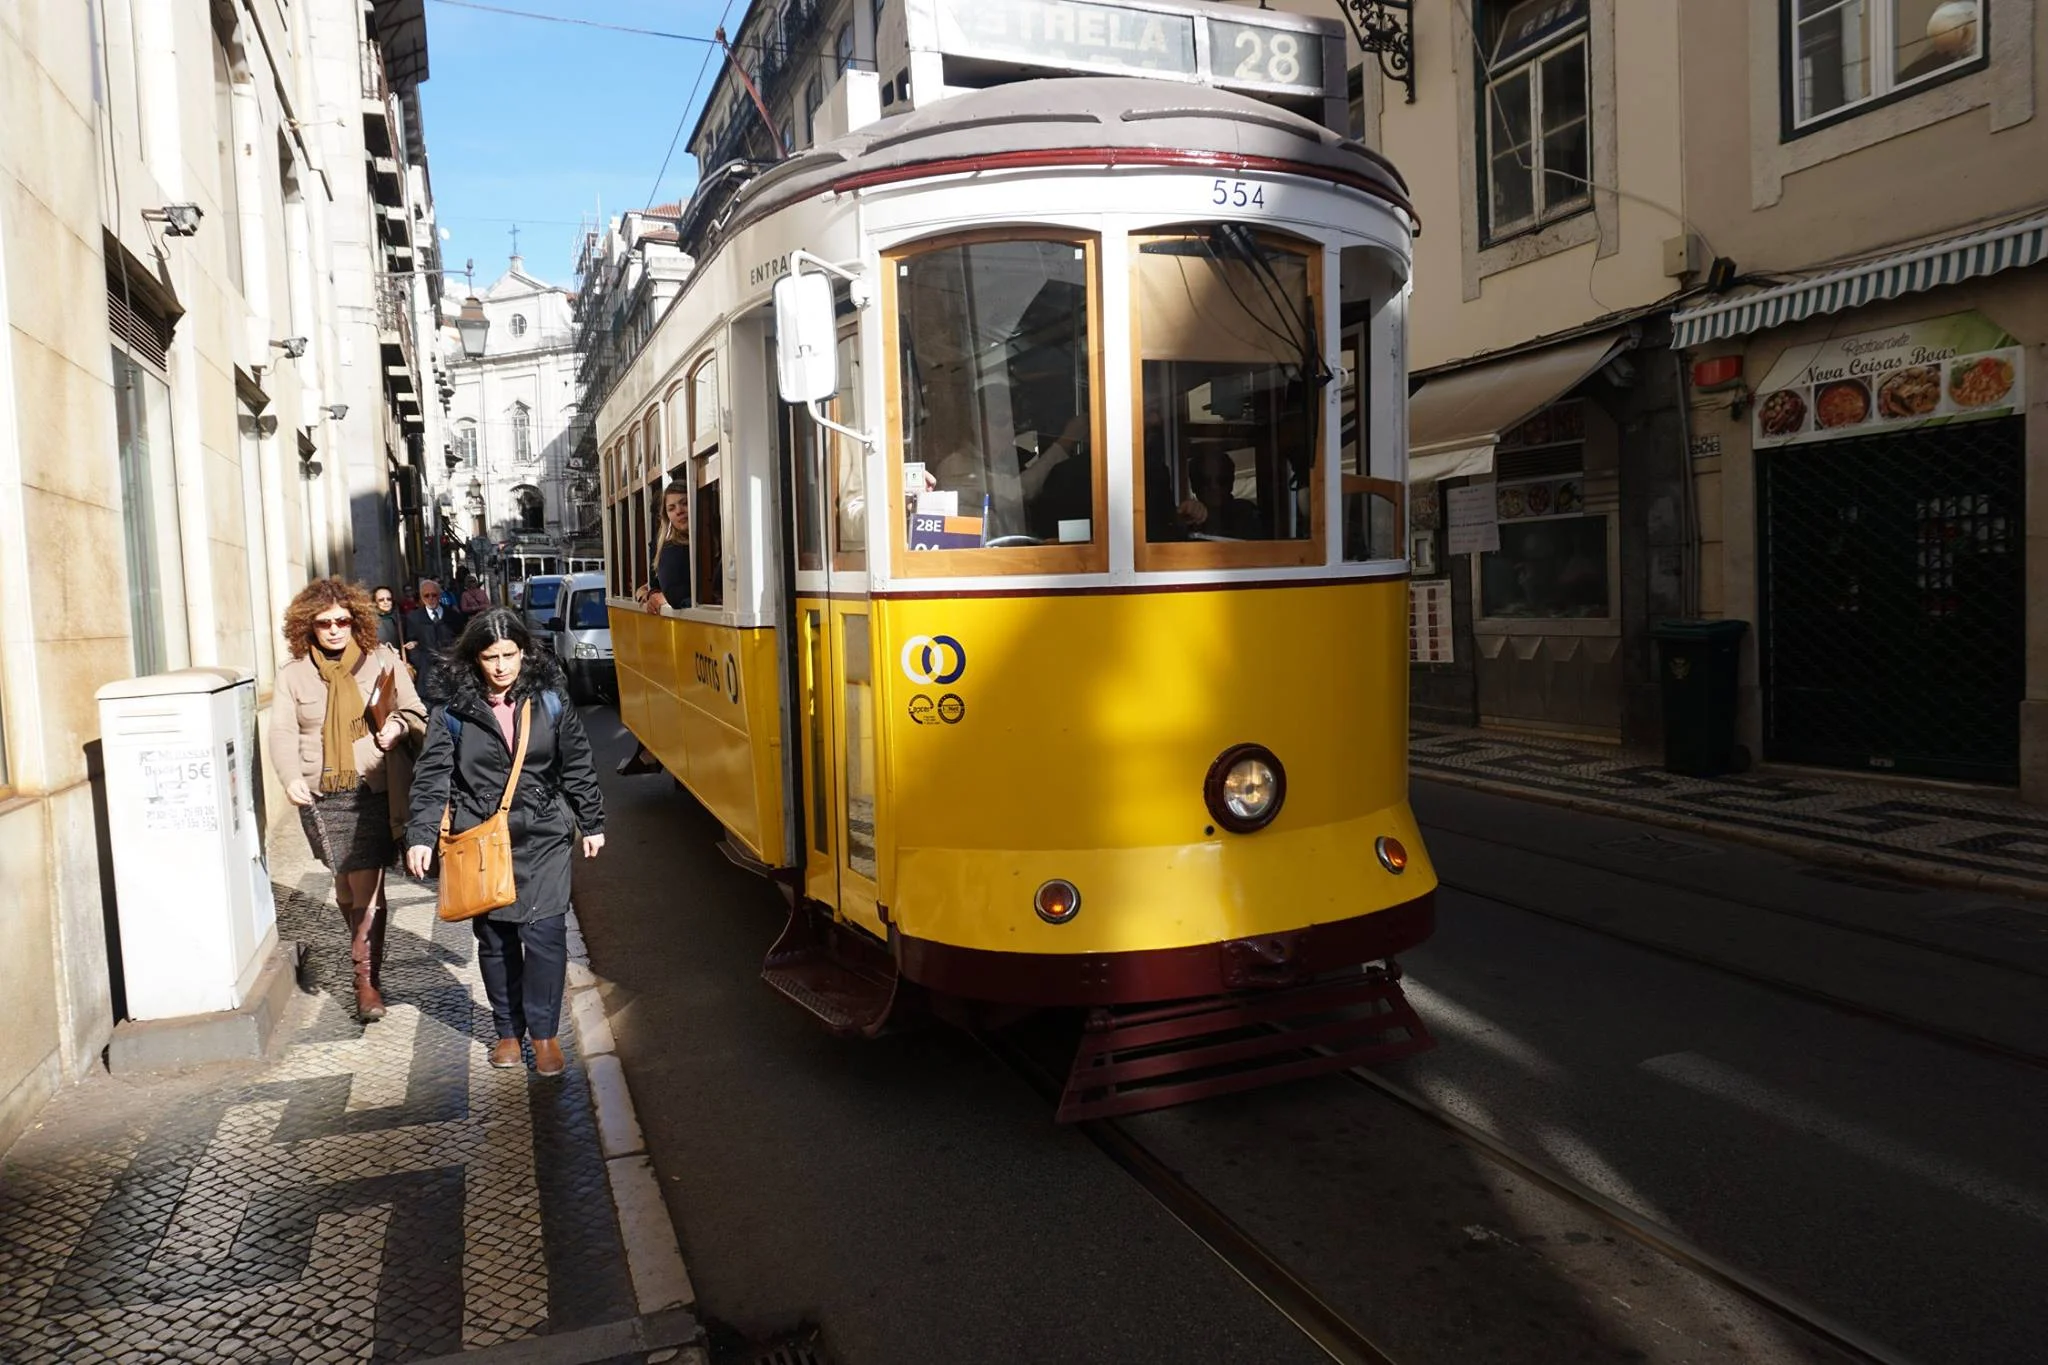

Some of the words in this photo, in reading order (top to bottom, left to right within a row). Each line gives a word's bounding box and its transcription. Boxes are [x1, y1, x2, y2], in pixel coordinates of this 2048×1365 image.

[964, 4, 1168, 53] STRELA
[1234, 30, 1300, 83] 28
[1212, 179, 1264, 209] 554
[750, 247, 808, 286] ENTRA
[1842, 332, 1911, 356] Restaurante
[1802, 366, 1844, 385] Nova
[1849, 356, 1902, 375] Coisas
[1909, 345, 1956, 365] Boas
[916, 518, 942, 532] 28E
[176, 762, 212, 780] 15€
